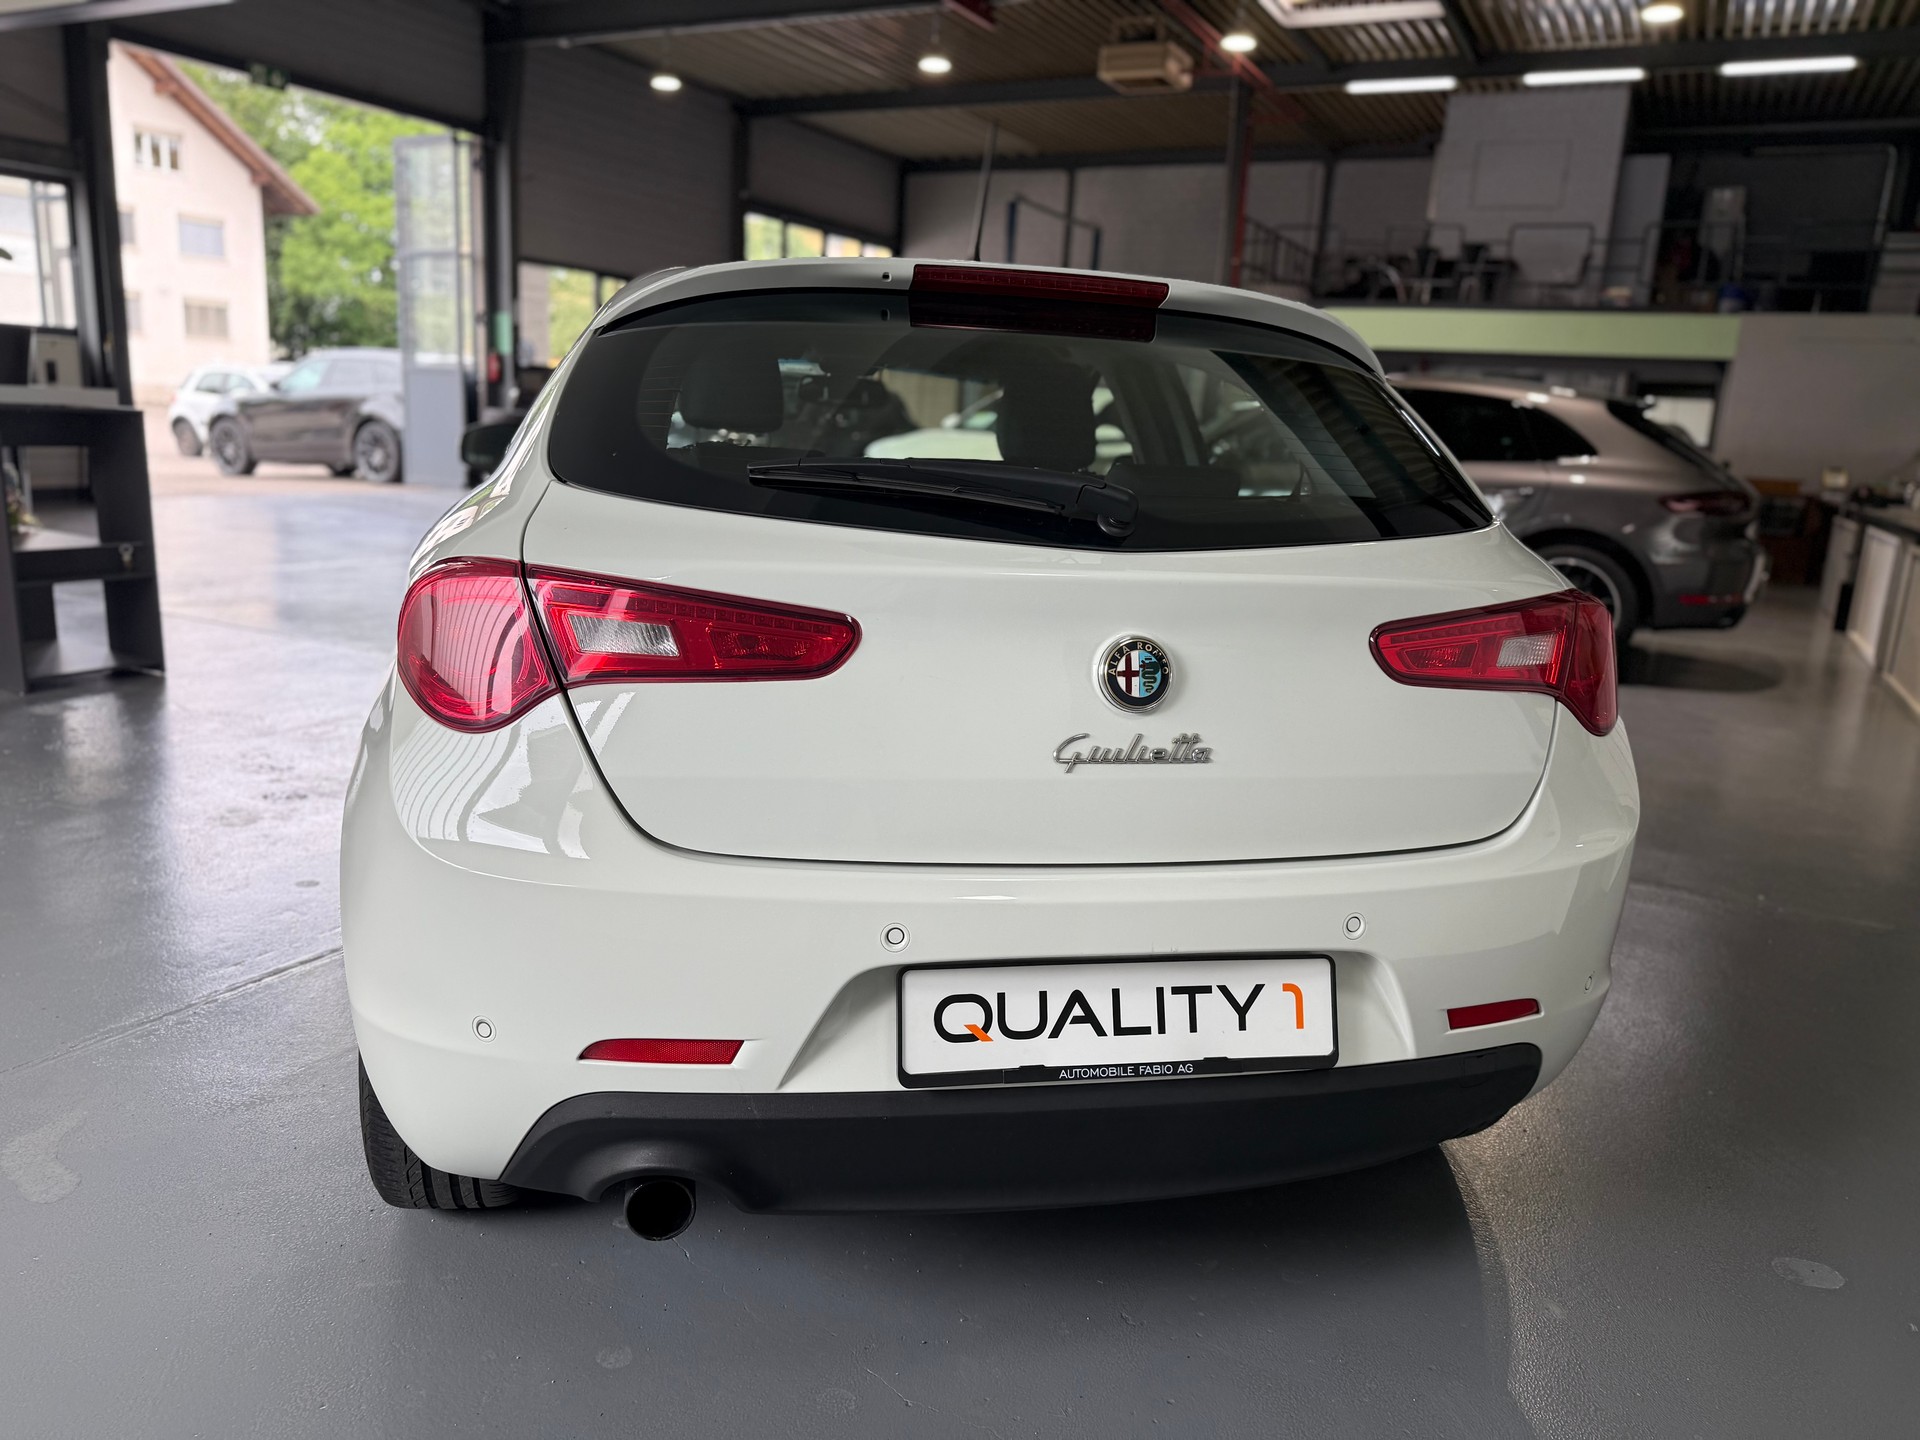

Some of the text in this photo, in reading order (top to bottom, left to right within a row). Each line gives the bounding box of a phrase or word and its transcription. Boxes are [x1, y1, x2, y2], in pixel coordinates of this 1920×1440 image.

[1108, 642, 1169, 676] ALFA ROMEO
[1053, 732, 1213, 774] Giulietta
[933, 983, 1305, 1044] QUALITY 1
[1059, 1063, 1194, 1079] AUTOMOBILE FABIO AG
